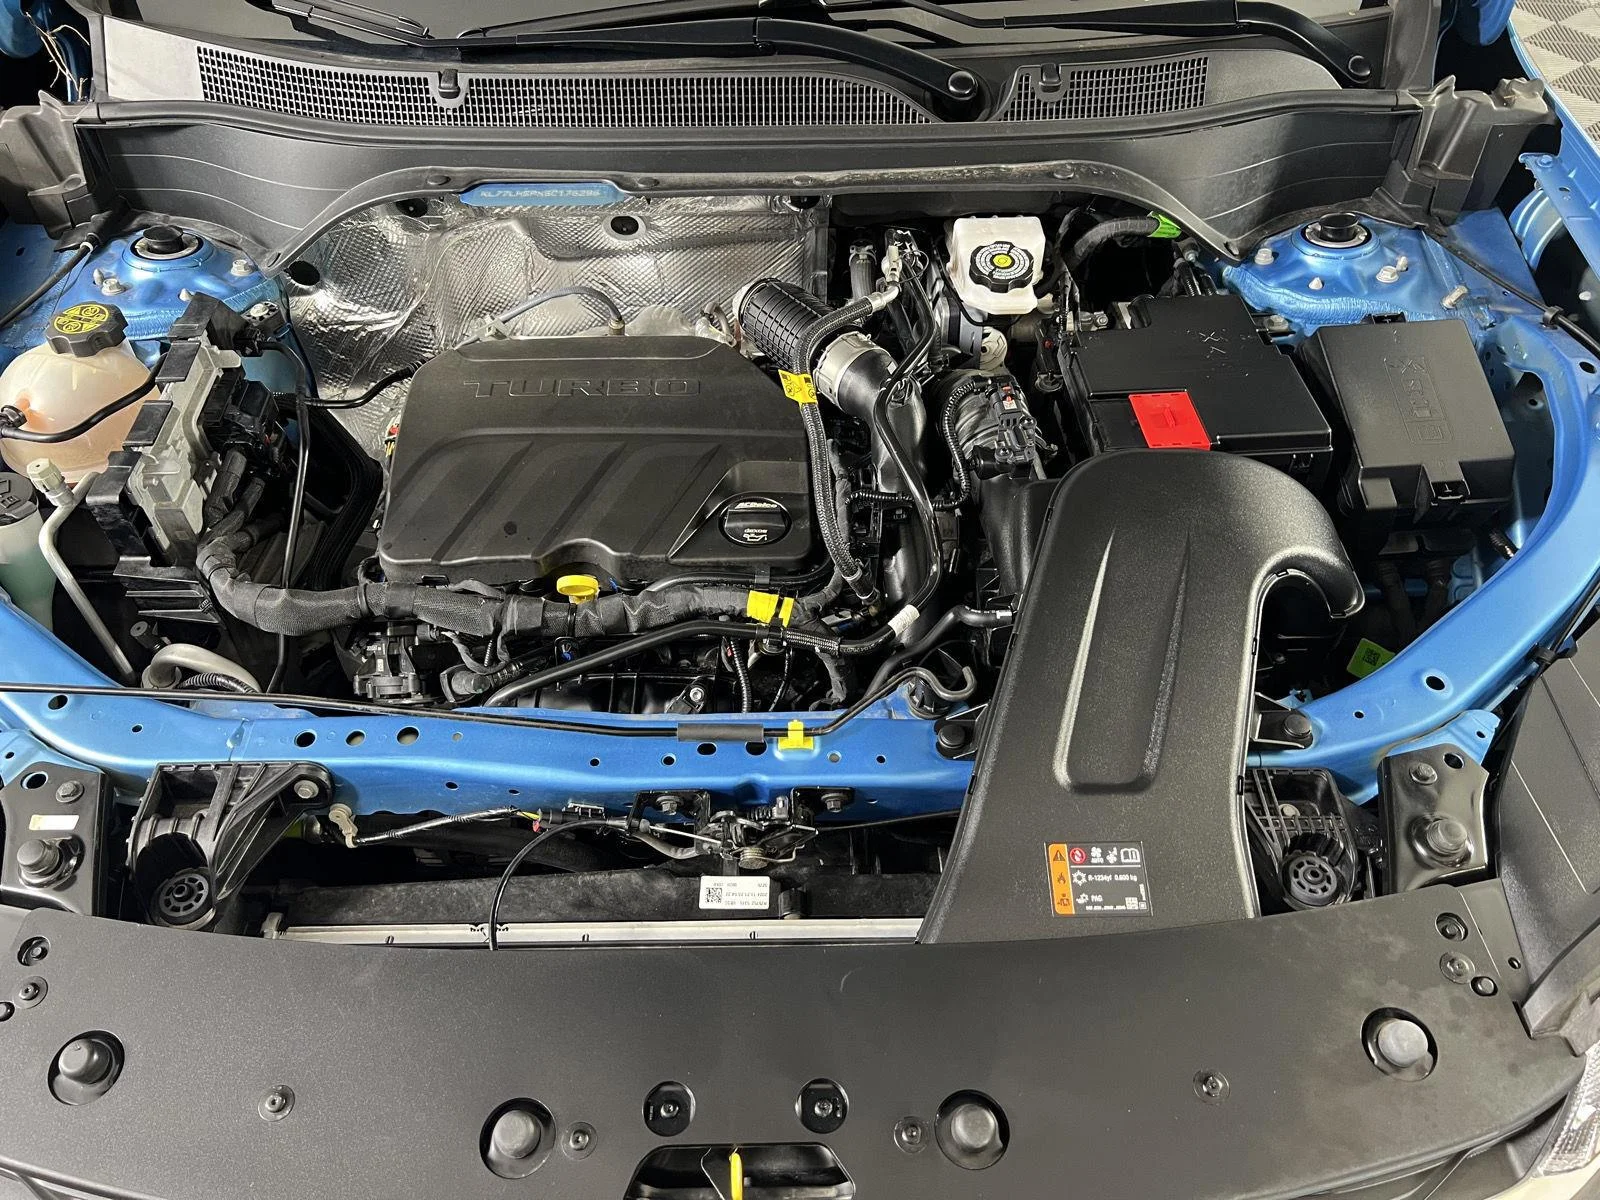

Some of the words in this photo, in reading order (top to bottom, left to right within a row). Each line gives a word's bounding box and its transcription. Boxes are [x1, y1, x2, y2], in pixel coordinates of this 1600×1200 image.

[463, 379, 700, 398] TURBO
[1088, 874, 1112, 882] R-1234yf
[1130, 874, 1138, 883] kg
